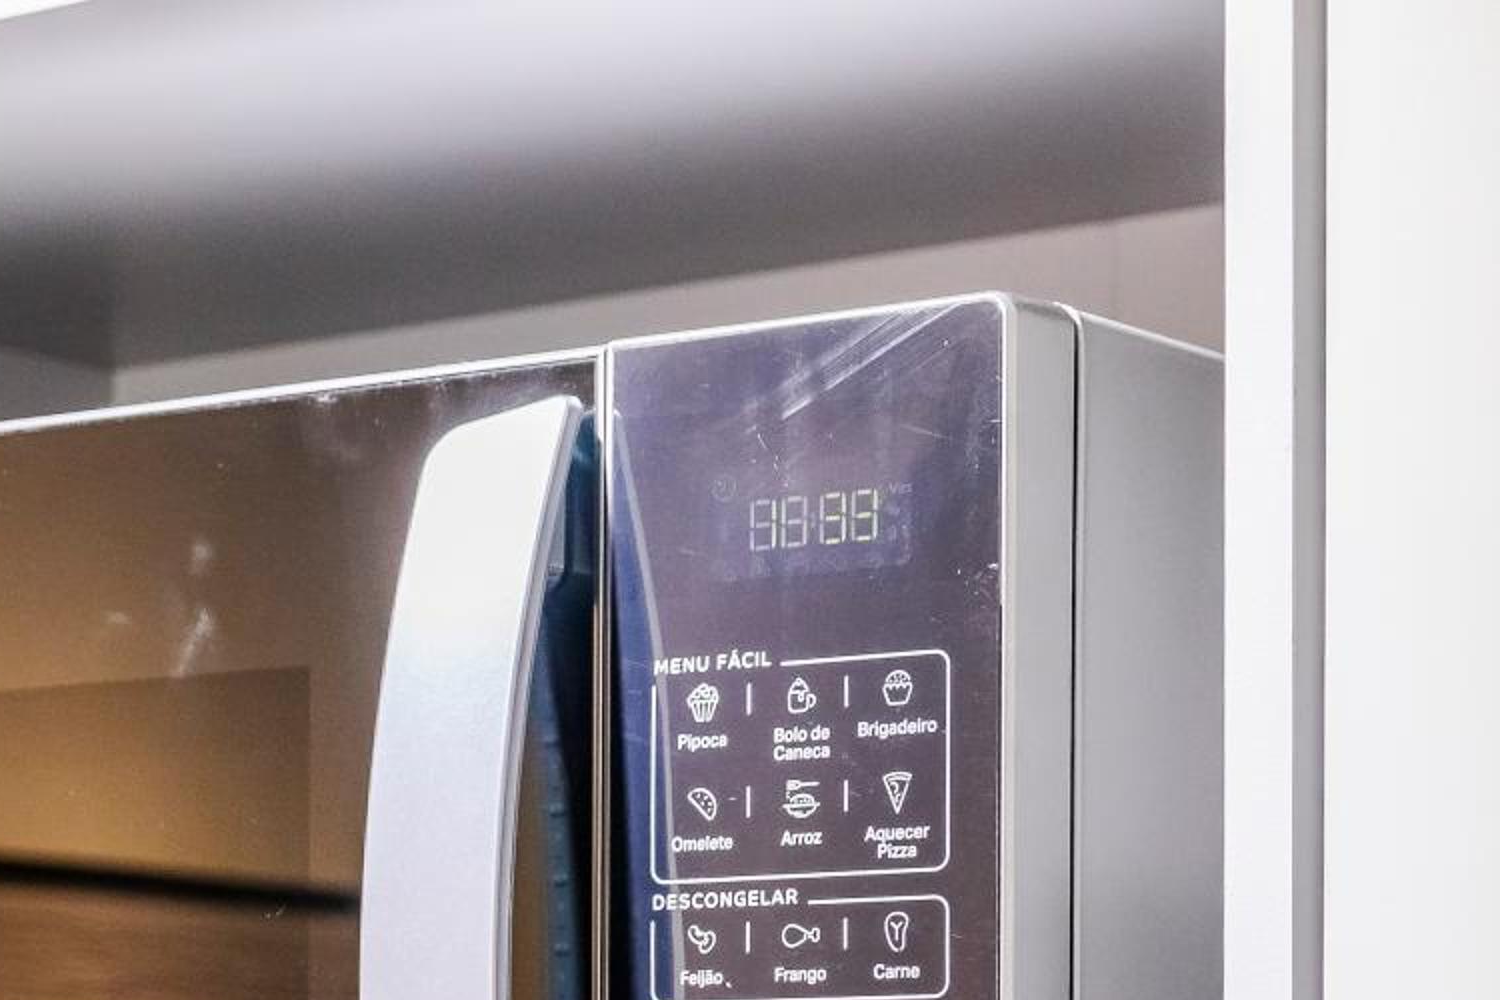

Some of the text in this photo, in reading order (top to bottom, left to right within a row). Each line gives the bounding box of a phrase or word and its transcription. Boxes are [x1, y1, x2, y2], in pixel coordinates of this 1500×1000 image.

[653, 650, 772, 676] MENU FÁCIL
[773, 725, 831, 744] Bolo de
[857, 719, 938, 739] Brigadeiro
[677, 734, 728, 752] Pipoca
[773, 745, 831, 761] Caneca
[671, 835, 733, 852] Omelete
[780, 831, 823, 847] Arroz
[864, 825, 930, 845] Aquecer
[877, 843, 918, 859] Pizza
[652, 888, 799, 911] DESCONGELAR
[680, 969, 723, 988] Feijão
[774, 966, 827, 985] Frango
[873, 963, 920, 979] Carne
